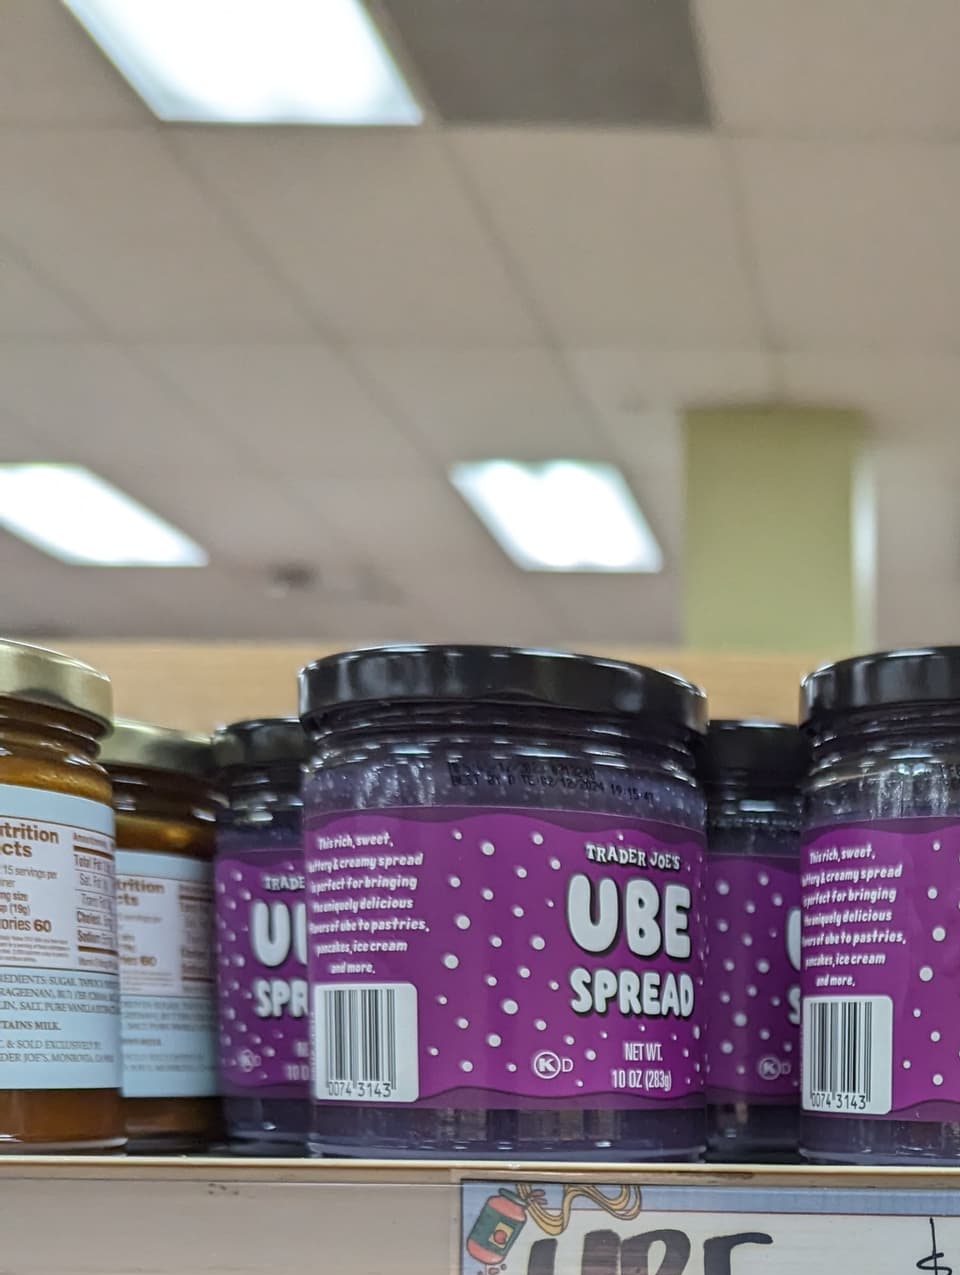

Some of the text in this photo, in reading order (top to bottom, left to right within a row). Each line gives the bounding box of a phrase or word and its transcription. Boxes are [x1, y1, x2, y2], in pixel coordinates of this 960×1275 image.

[340, 856, 376, 870] creamy
[378, 852, 424, 869] spread
[586, 844, 682, 870] TRADER JOE'S
[826, 868, 860, 883] creamy
[860, 864, 904, 883] spread
[263, 875, 305, 891] TRADE
[347, 876, 364, 890] for
[365, 874, 418, 891] bringing
[360, 896, 414, 910] delicious
[831, 889, 848, 905] for
[848, 886, 898, 904] bringing
[567, 874, 692, 959] UBE
[843, 908, 893, 922] delicious
[33, 918, 53, 933] 60
[358, 918, 370, 931] to
[825, 932, 840, 945] ube
[841, 930, 852, 945] to
[353, 939, 369, 953] ice
[370, 941, 408, 952] cream
[835, 952, 850, 966] ice
[850, 953, 886, 965] cream
[568, 967, 695, 1018] SPREAD
[2, 1020, 33, 1030] TAINS
[624, 1042, 644, 1062] NET
[611, 1069, 673, 1093] 10 OZ (283g)
[357, 1082, 393, 1098] 3143
[836, 1094, 867, 1110] 3143
